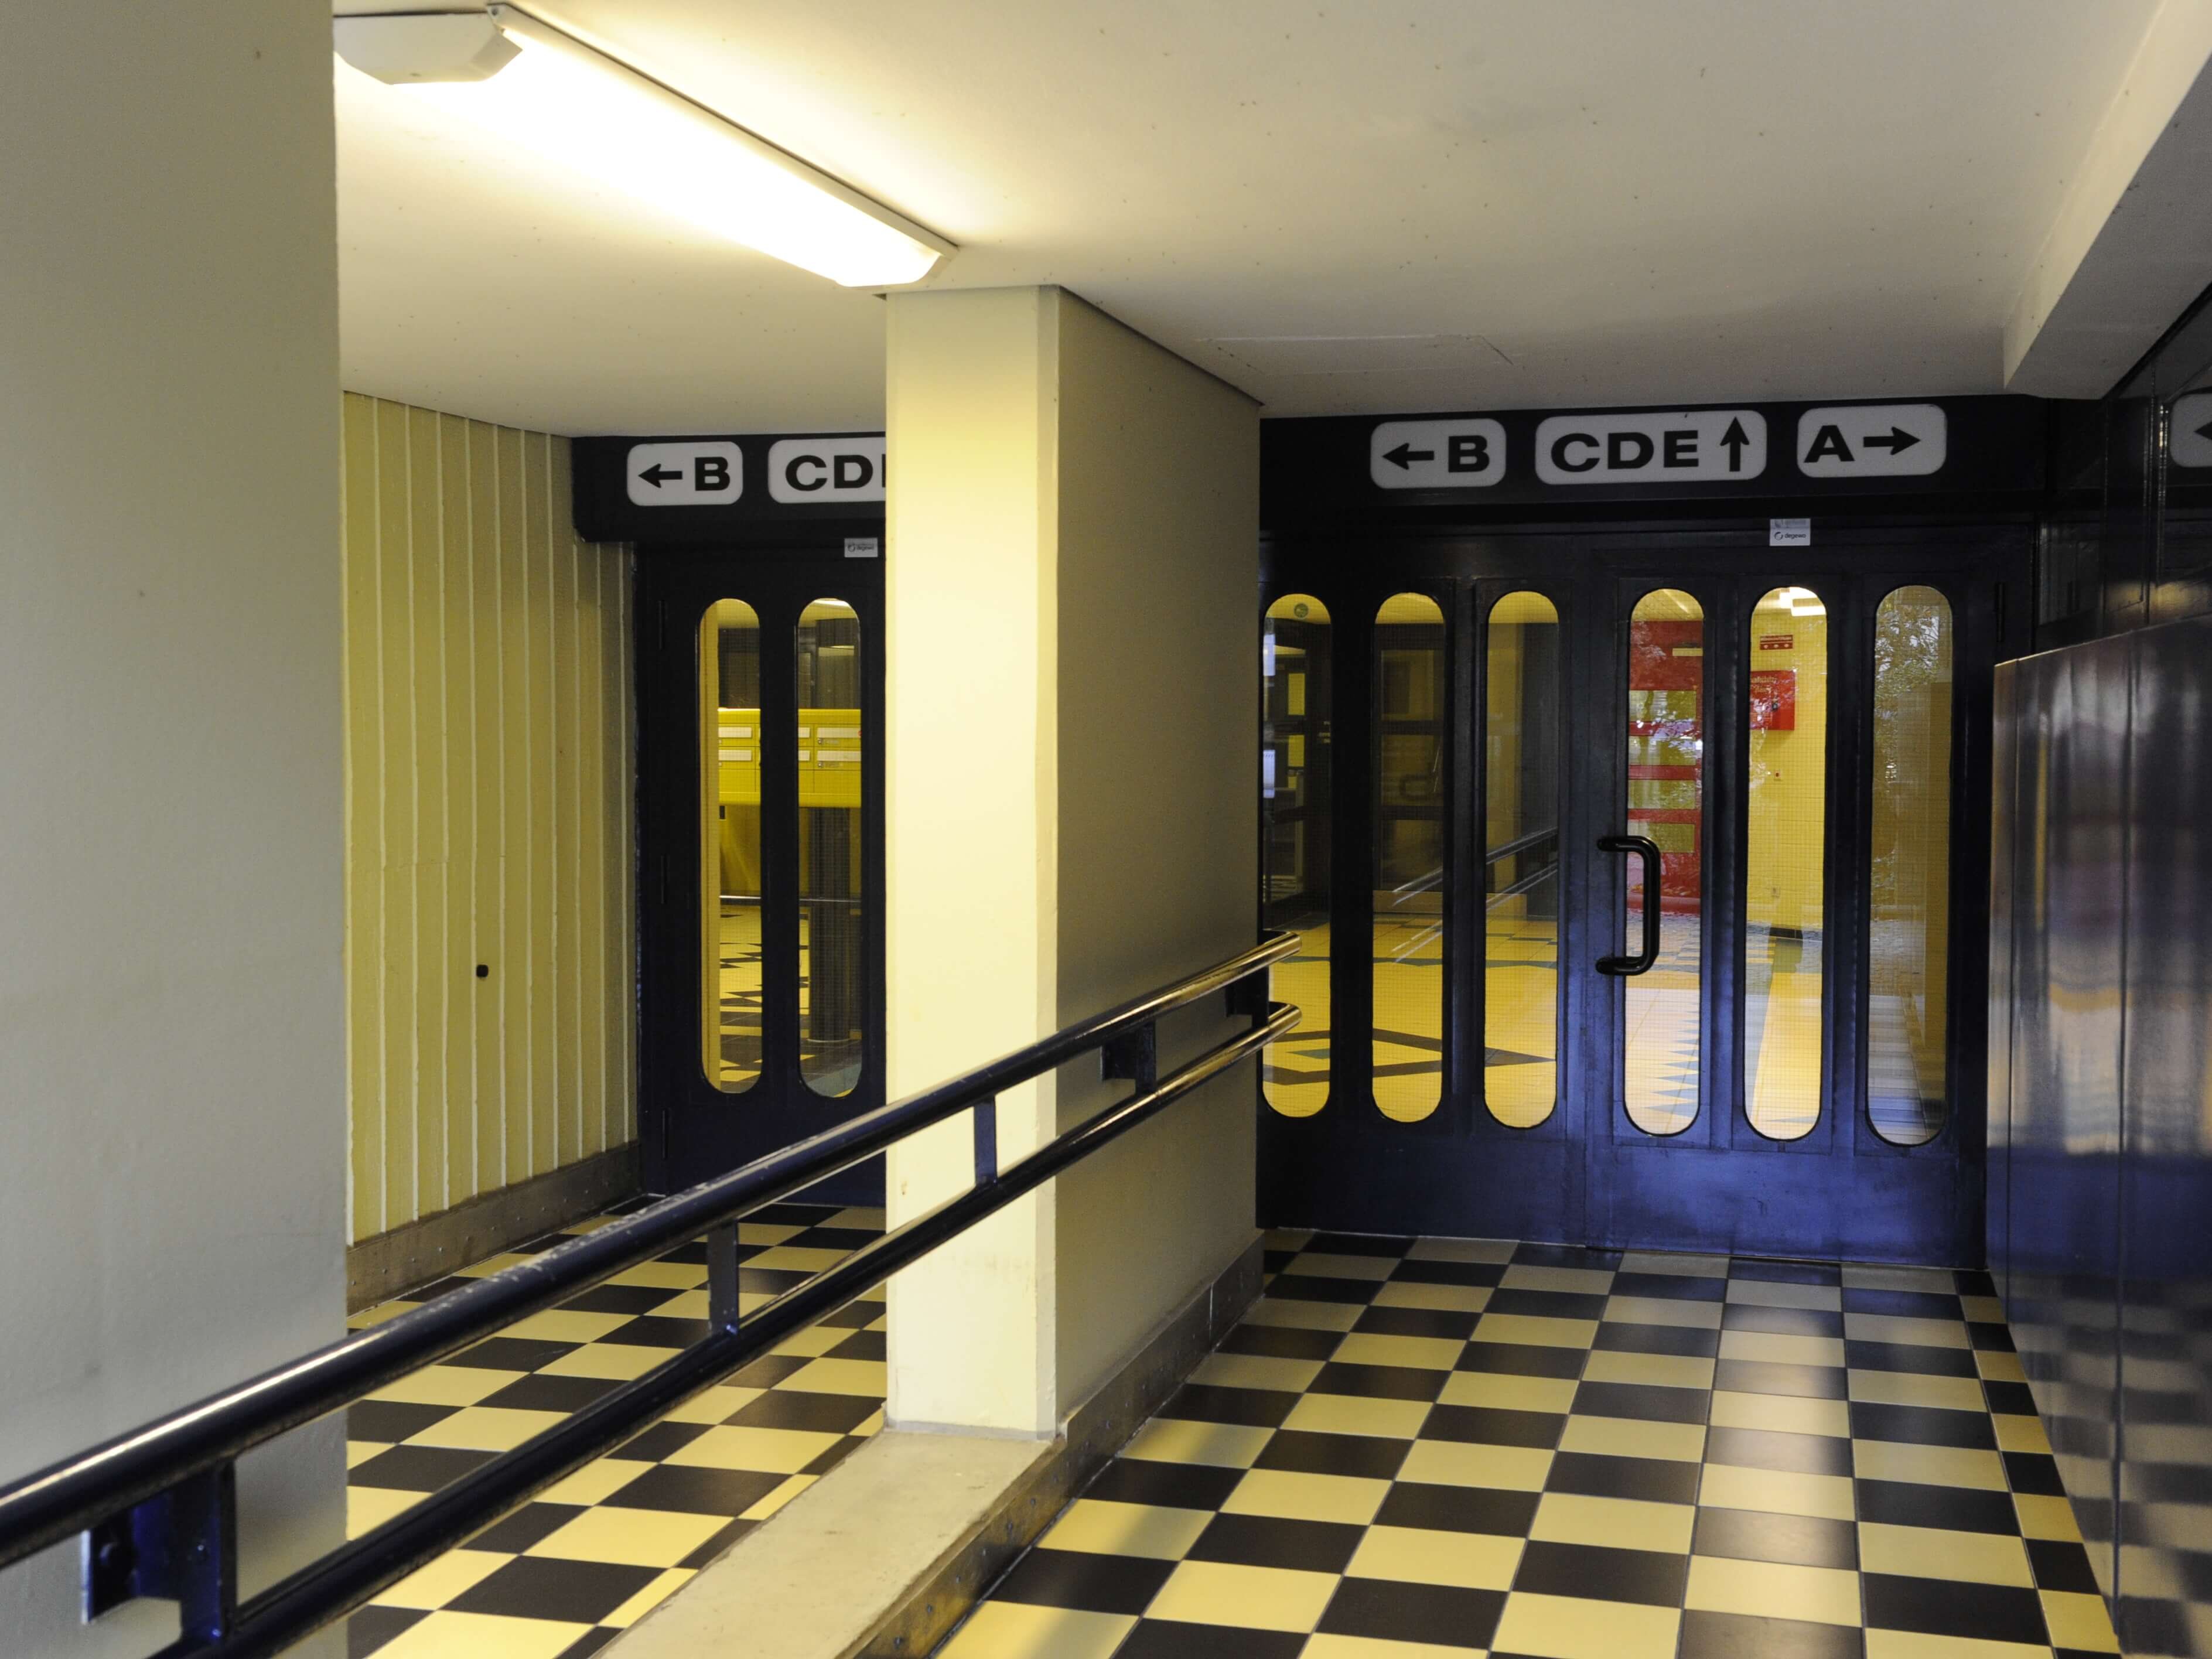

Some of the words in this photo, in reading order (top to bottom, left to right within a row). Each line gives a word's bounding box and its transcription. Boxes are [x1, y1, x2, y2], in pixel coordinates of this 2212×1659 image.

[1448, 435, 1490, 473] B
[1551, 429, 1699, 473] CDE
[1804, 425, 1855, 463] A
[695, 457, 730, 491] B
[786, 454, 885, 491] CD
